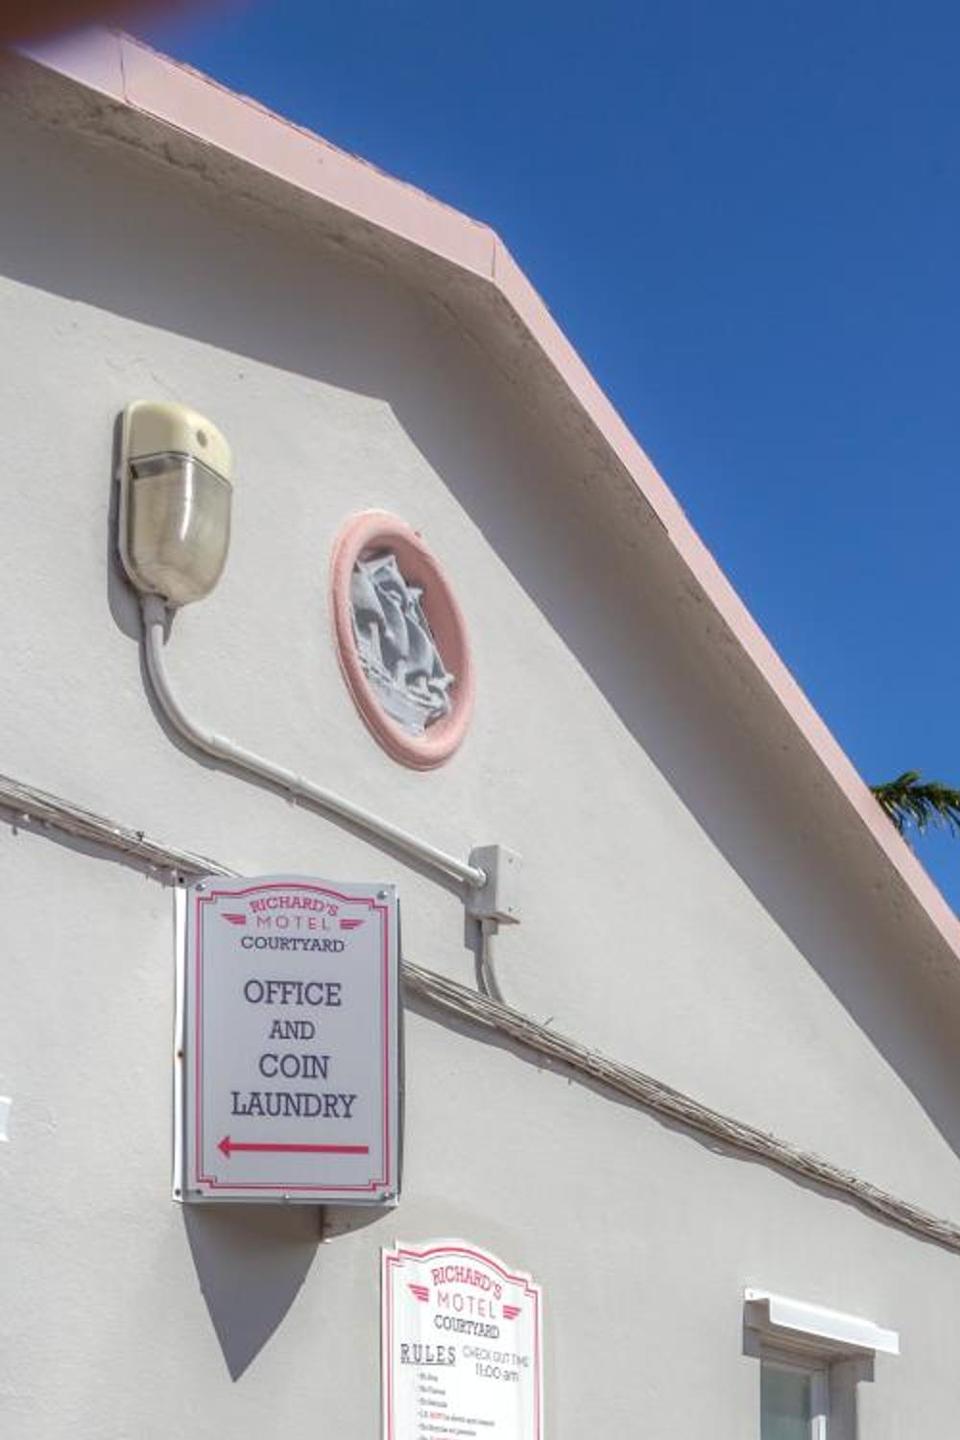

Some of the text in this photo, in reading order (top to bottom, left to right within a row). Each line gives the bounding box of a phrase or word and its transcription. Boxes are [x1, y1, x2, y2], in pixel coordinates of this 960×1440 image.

[250, 896, 339, 917] RICHARD'S
[257, 915, 331, 931] MOTEL
[241, 936, 345, 953] COURTYARD
[244, 980, 342, 1007] OFFICE
[269, 1020, 316, 1040] AND
[259, 1054, 330, 1079] COIN
[231, 1091, 357, 1119] LAUNDRY
[431, 1265, 502, 1300] RICHARD'S
[437, 1290, 497, 1319] MOTEL
[434, 1314, 500, 1339] COURTYARD
[400, 1343, 456, 1365] RULES
